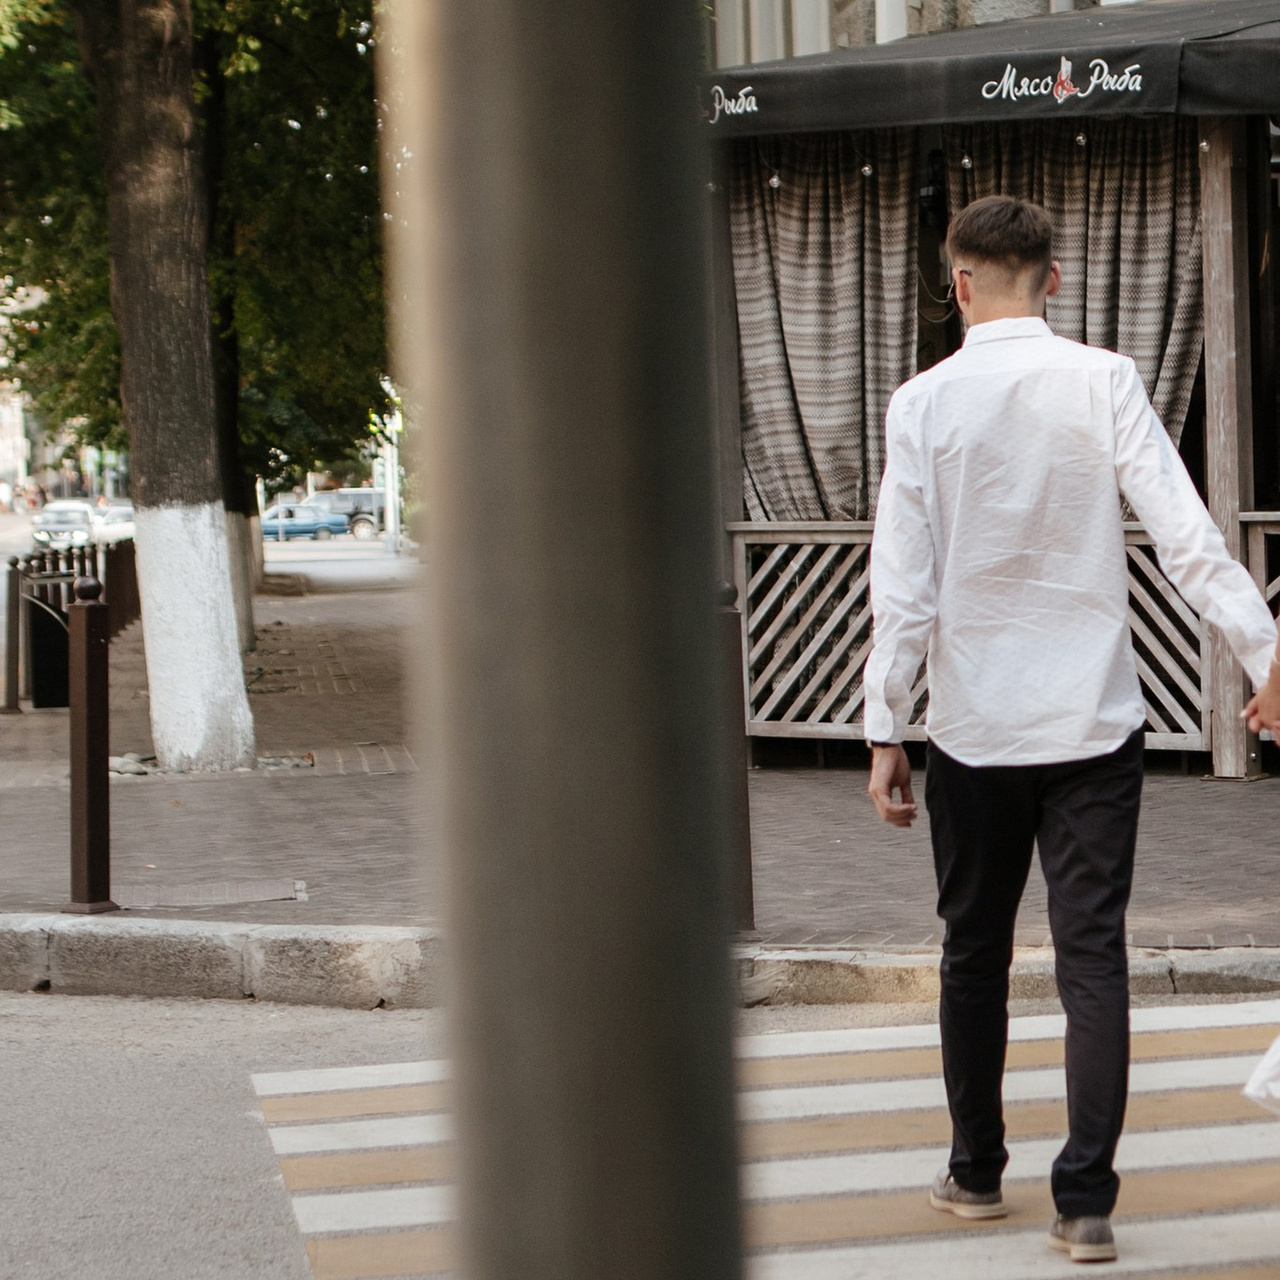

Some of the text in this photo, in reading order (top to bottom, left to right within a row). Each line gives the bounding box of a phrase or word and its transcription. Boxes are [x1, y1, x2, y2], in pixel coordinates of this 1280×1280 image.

[981, 63, 1053, 101] Мясо
[1077, 58, 1143, 97] Рыба
[709, 85, 758, 124] Рыба
